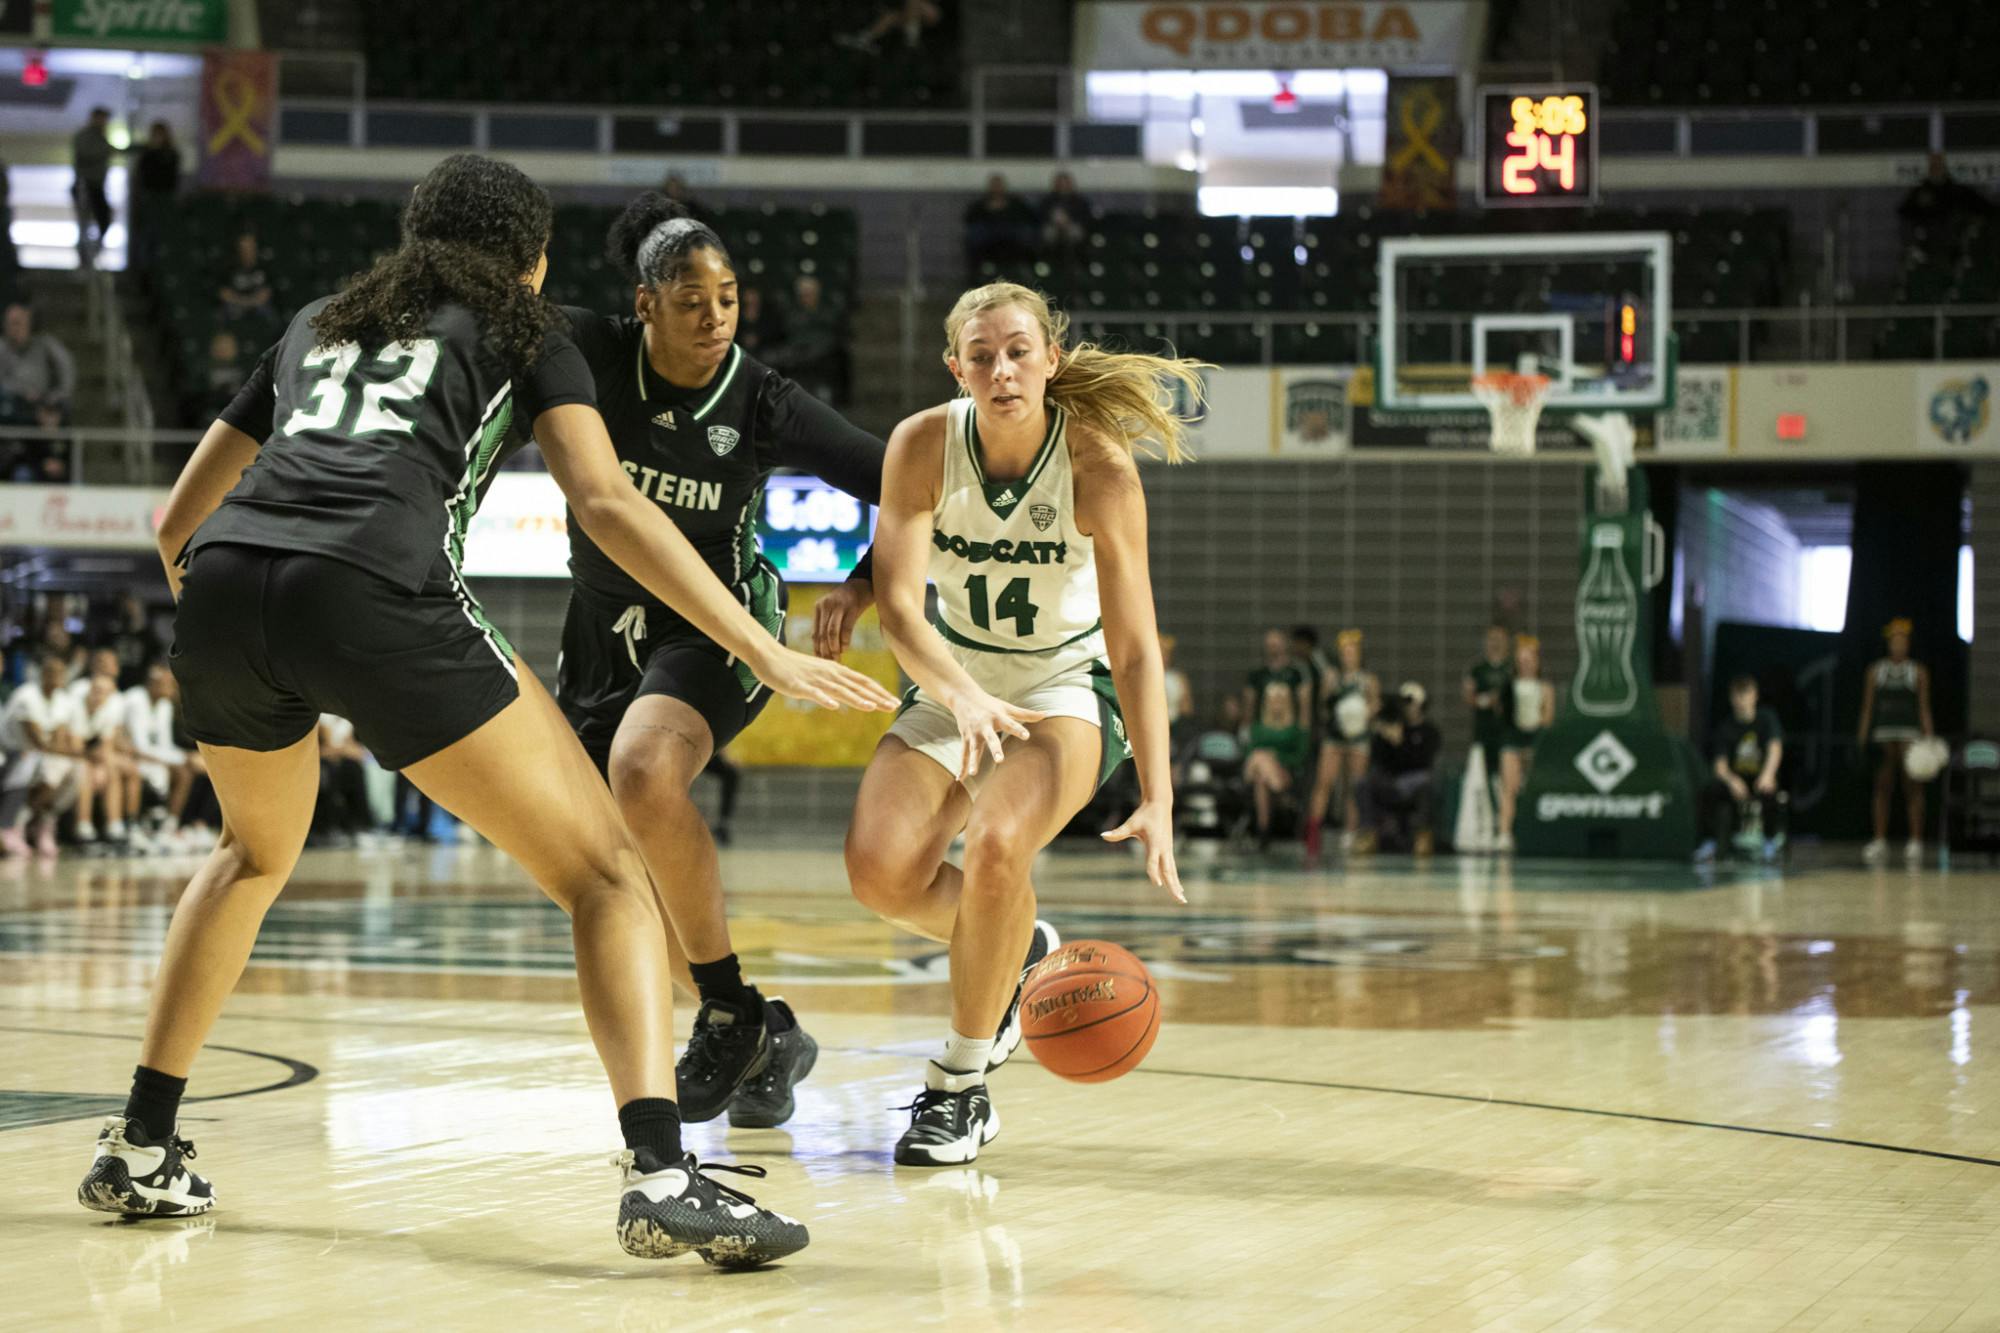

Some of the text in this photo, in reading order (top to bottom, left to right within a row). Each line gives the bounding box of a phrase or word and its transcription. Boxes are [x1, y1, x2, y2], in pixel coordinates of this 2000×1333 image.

[74, 0, 204, 37] Sprite
[1140, 5, 1421, 56] QDOBA
[1502, 131, 1575, 194] 24
[282, 338, 441, 438] 32
[651, 416, 677, 431] adidas
[992, 497, 1018, 507] adidas
[963, 573, 1040, 638] 14
[1537, 792, 1663, 822] gomart
[1028, 976, 1116, 1026] SPALDING
